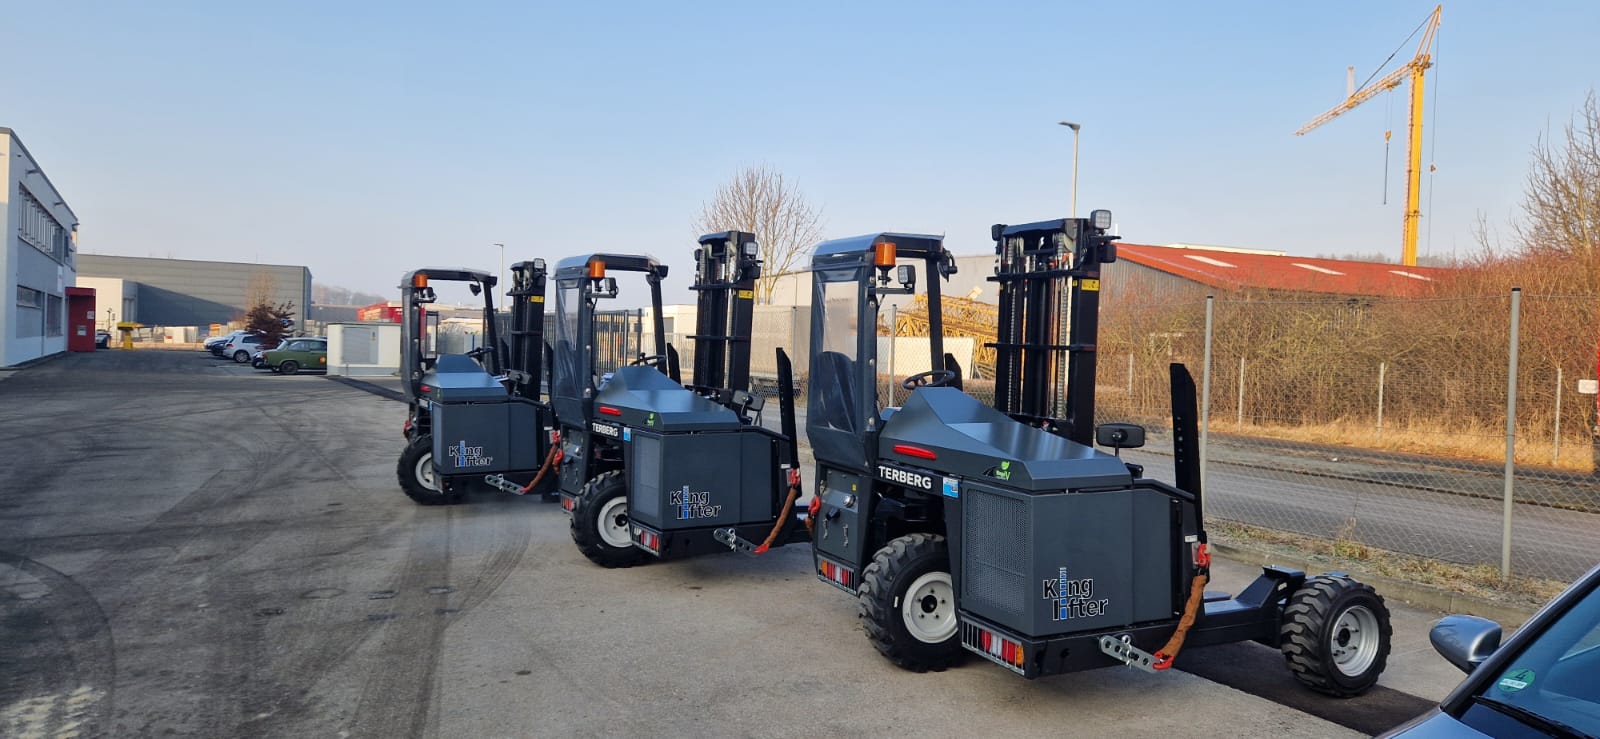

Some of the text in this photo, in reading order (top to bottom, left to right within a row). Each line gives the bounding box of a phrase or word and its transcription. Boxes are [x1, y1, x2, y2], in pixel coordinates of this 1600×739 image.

[592, 422, 619, 437] TERBERG
[878, 465, 932, 490] TERBERG
[670, 485, 710, 506] King
[1042, 567, 1094, 600] King
